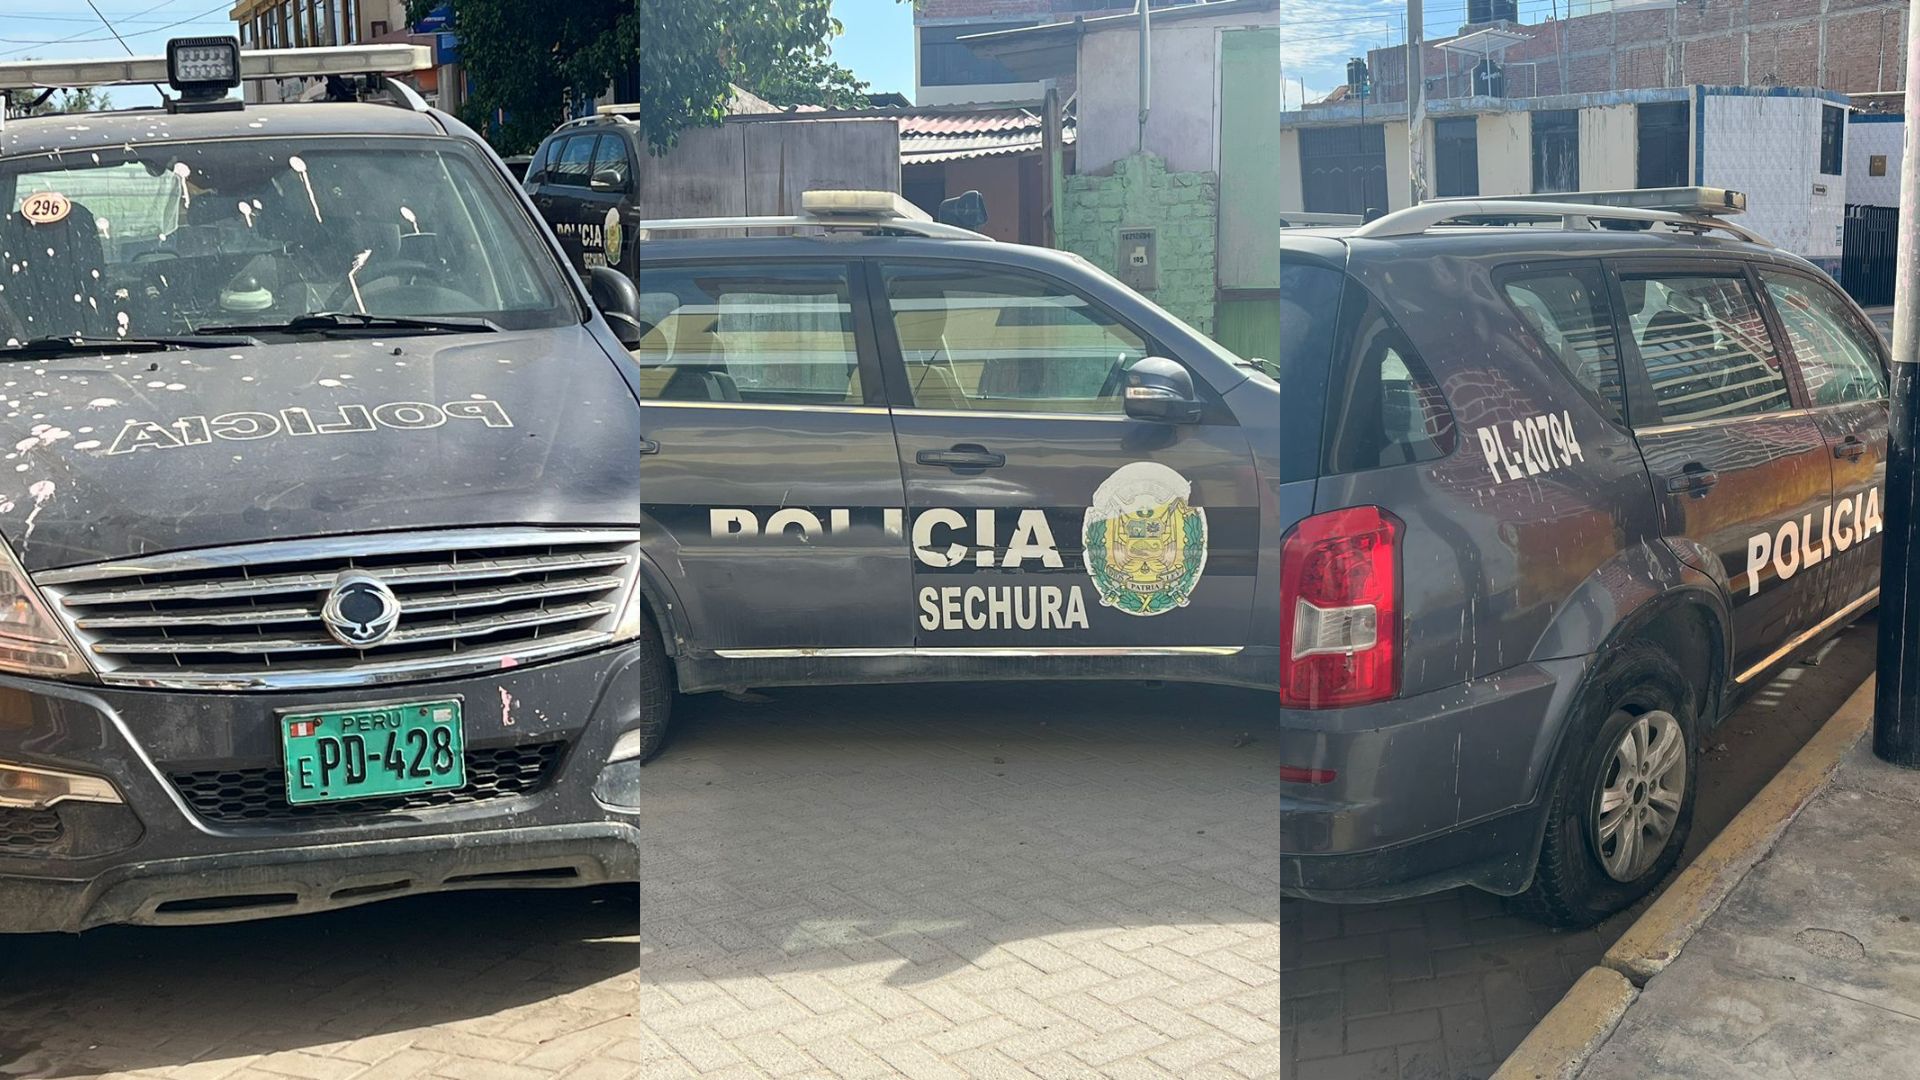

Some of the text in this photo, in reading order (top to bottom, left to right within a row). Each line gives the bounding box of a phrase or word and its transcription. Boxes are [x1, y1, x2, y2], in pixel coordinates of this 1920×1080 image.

[31, 199, 60, 216] 296
[1477, 410, 1584, 484] PL-20794
[1747, 487, 1883, 596] POLICIA
[1130, 583, 1160, 591] PATRIA
[919, 586, 1090, 631] SECHURA
[342, 711, 404, 732] PERU
